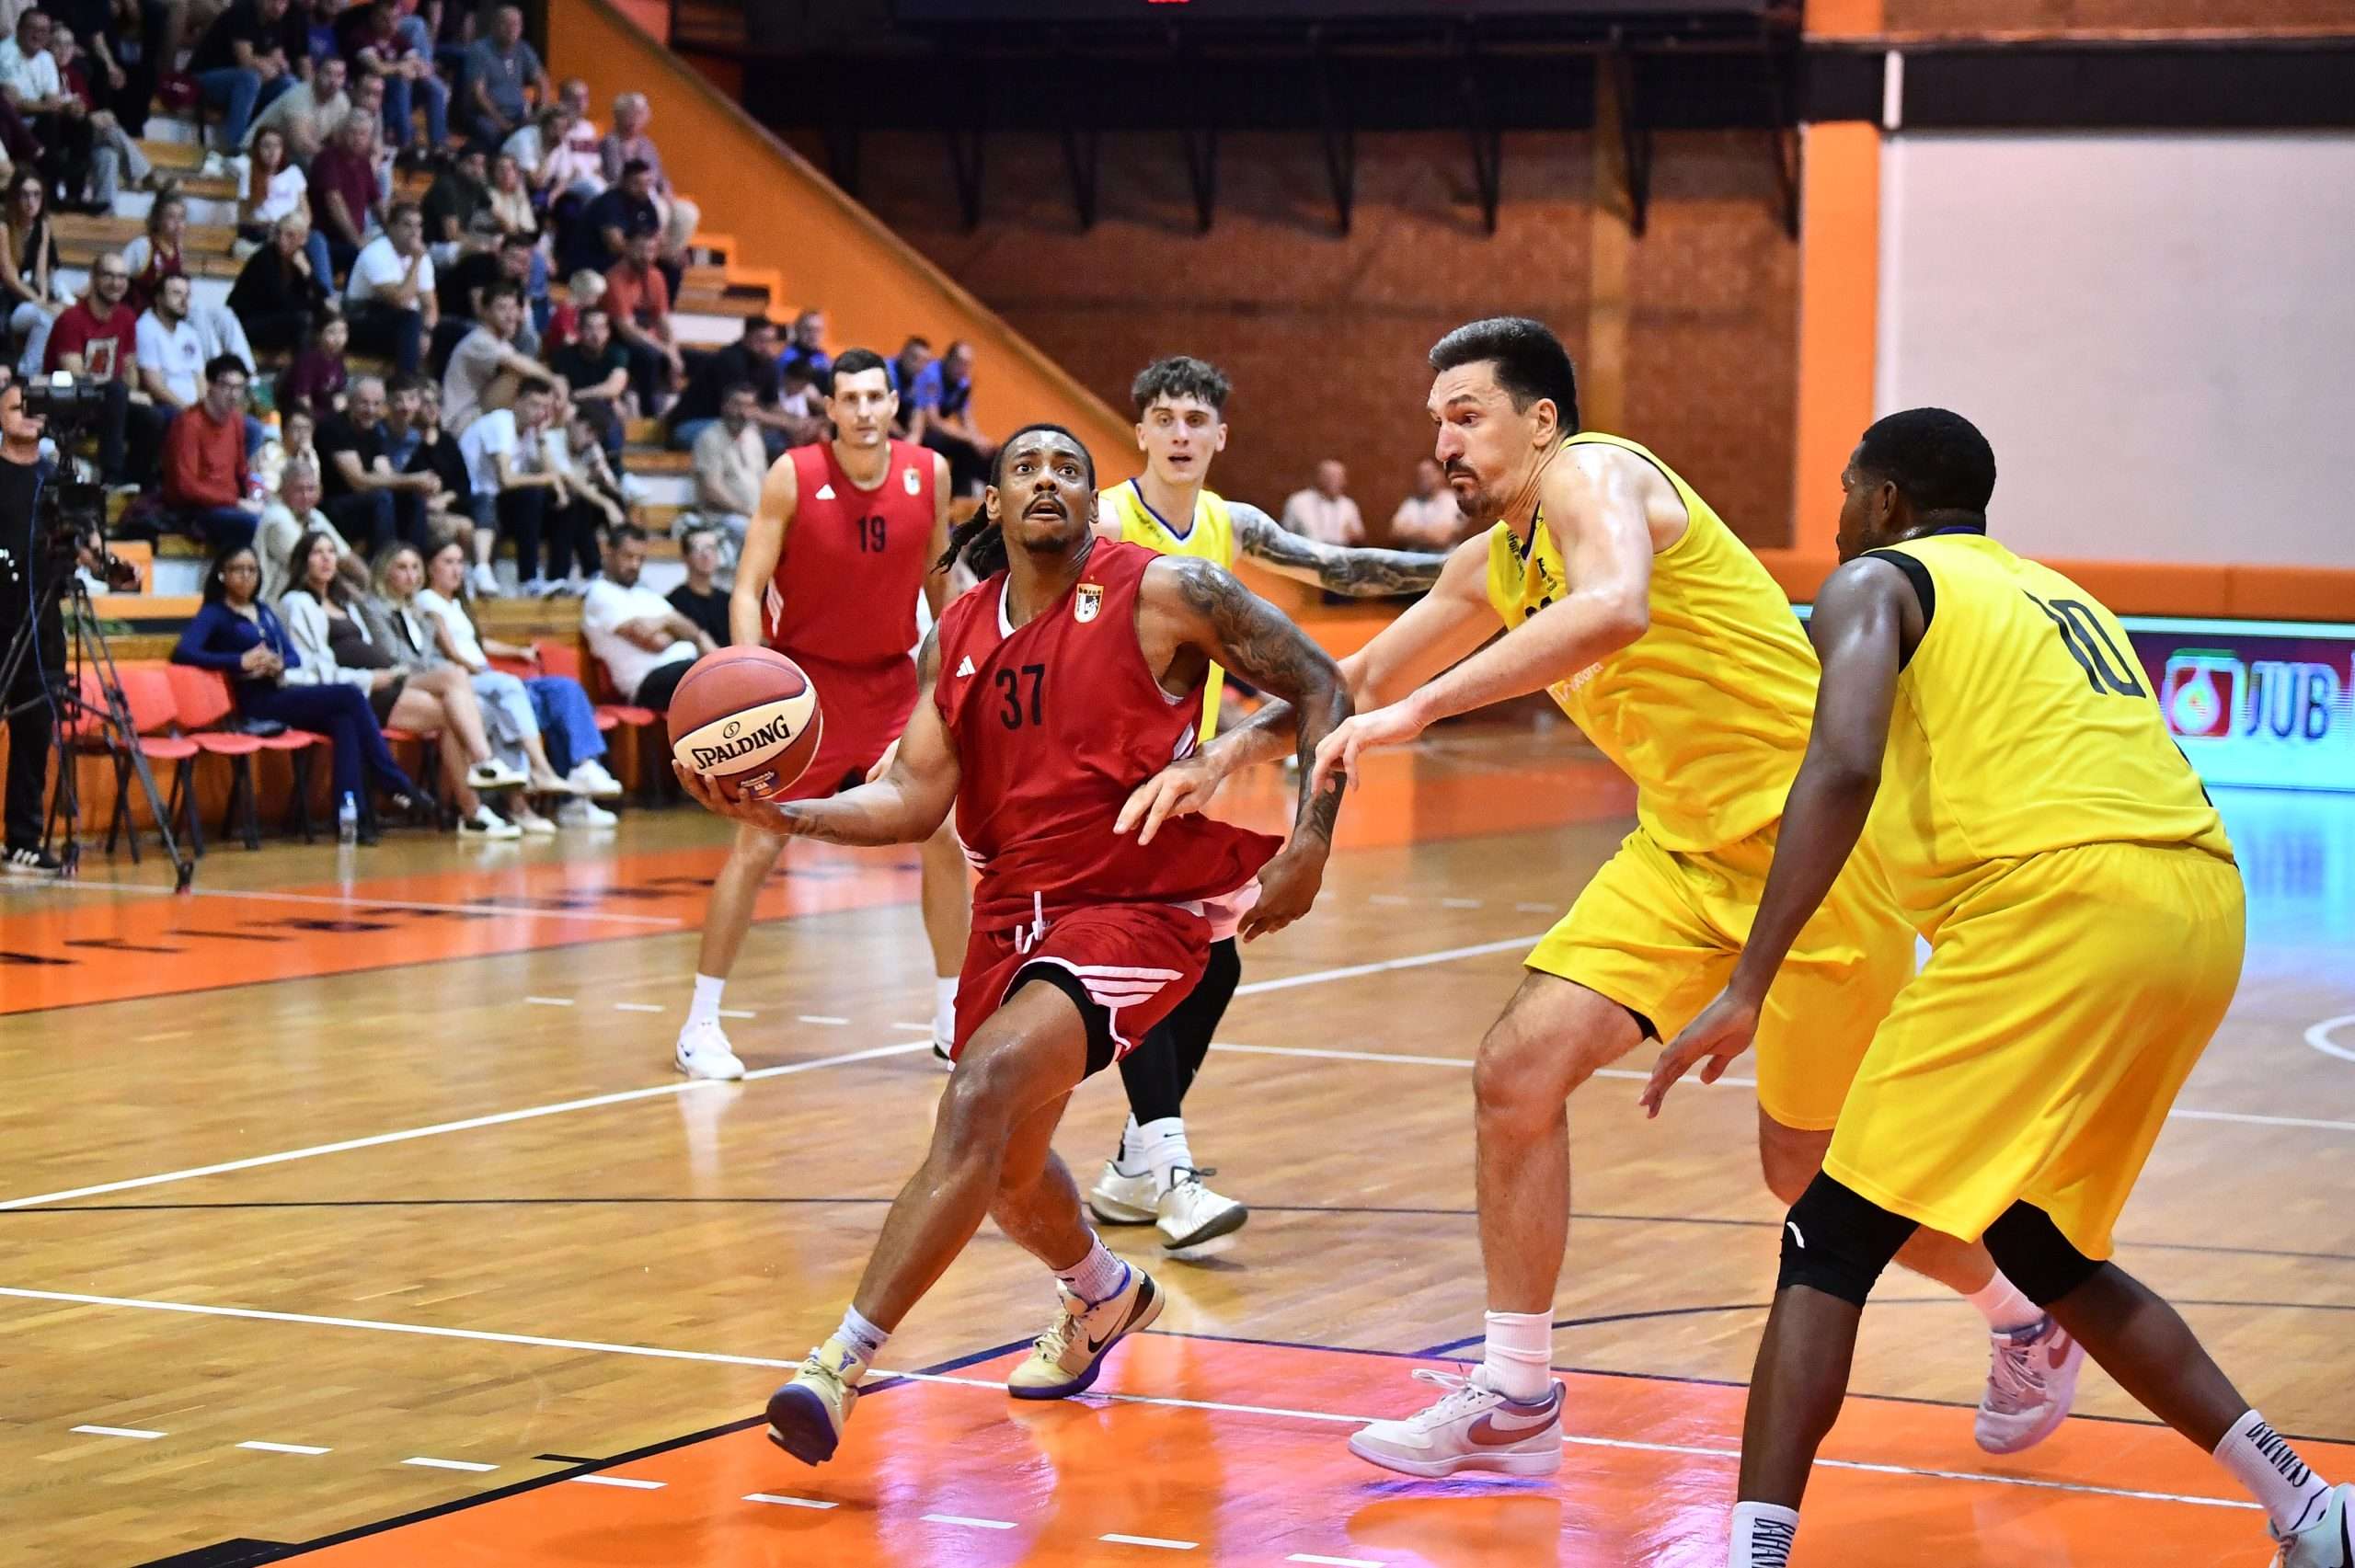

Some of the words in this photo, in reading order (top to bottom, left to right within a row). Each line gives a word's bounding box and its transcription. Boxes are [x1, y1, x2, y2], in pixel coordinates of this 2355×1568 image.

[857, 516, 886, 554] 19
[2021, 589, 2146, 698] 10
[996, 664, 1045, 729] 37
[2245, 661, 2338, 740] JUB
[692, 715, 790, 770] SPALDING
